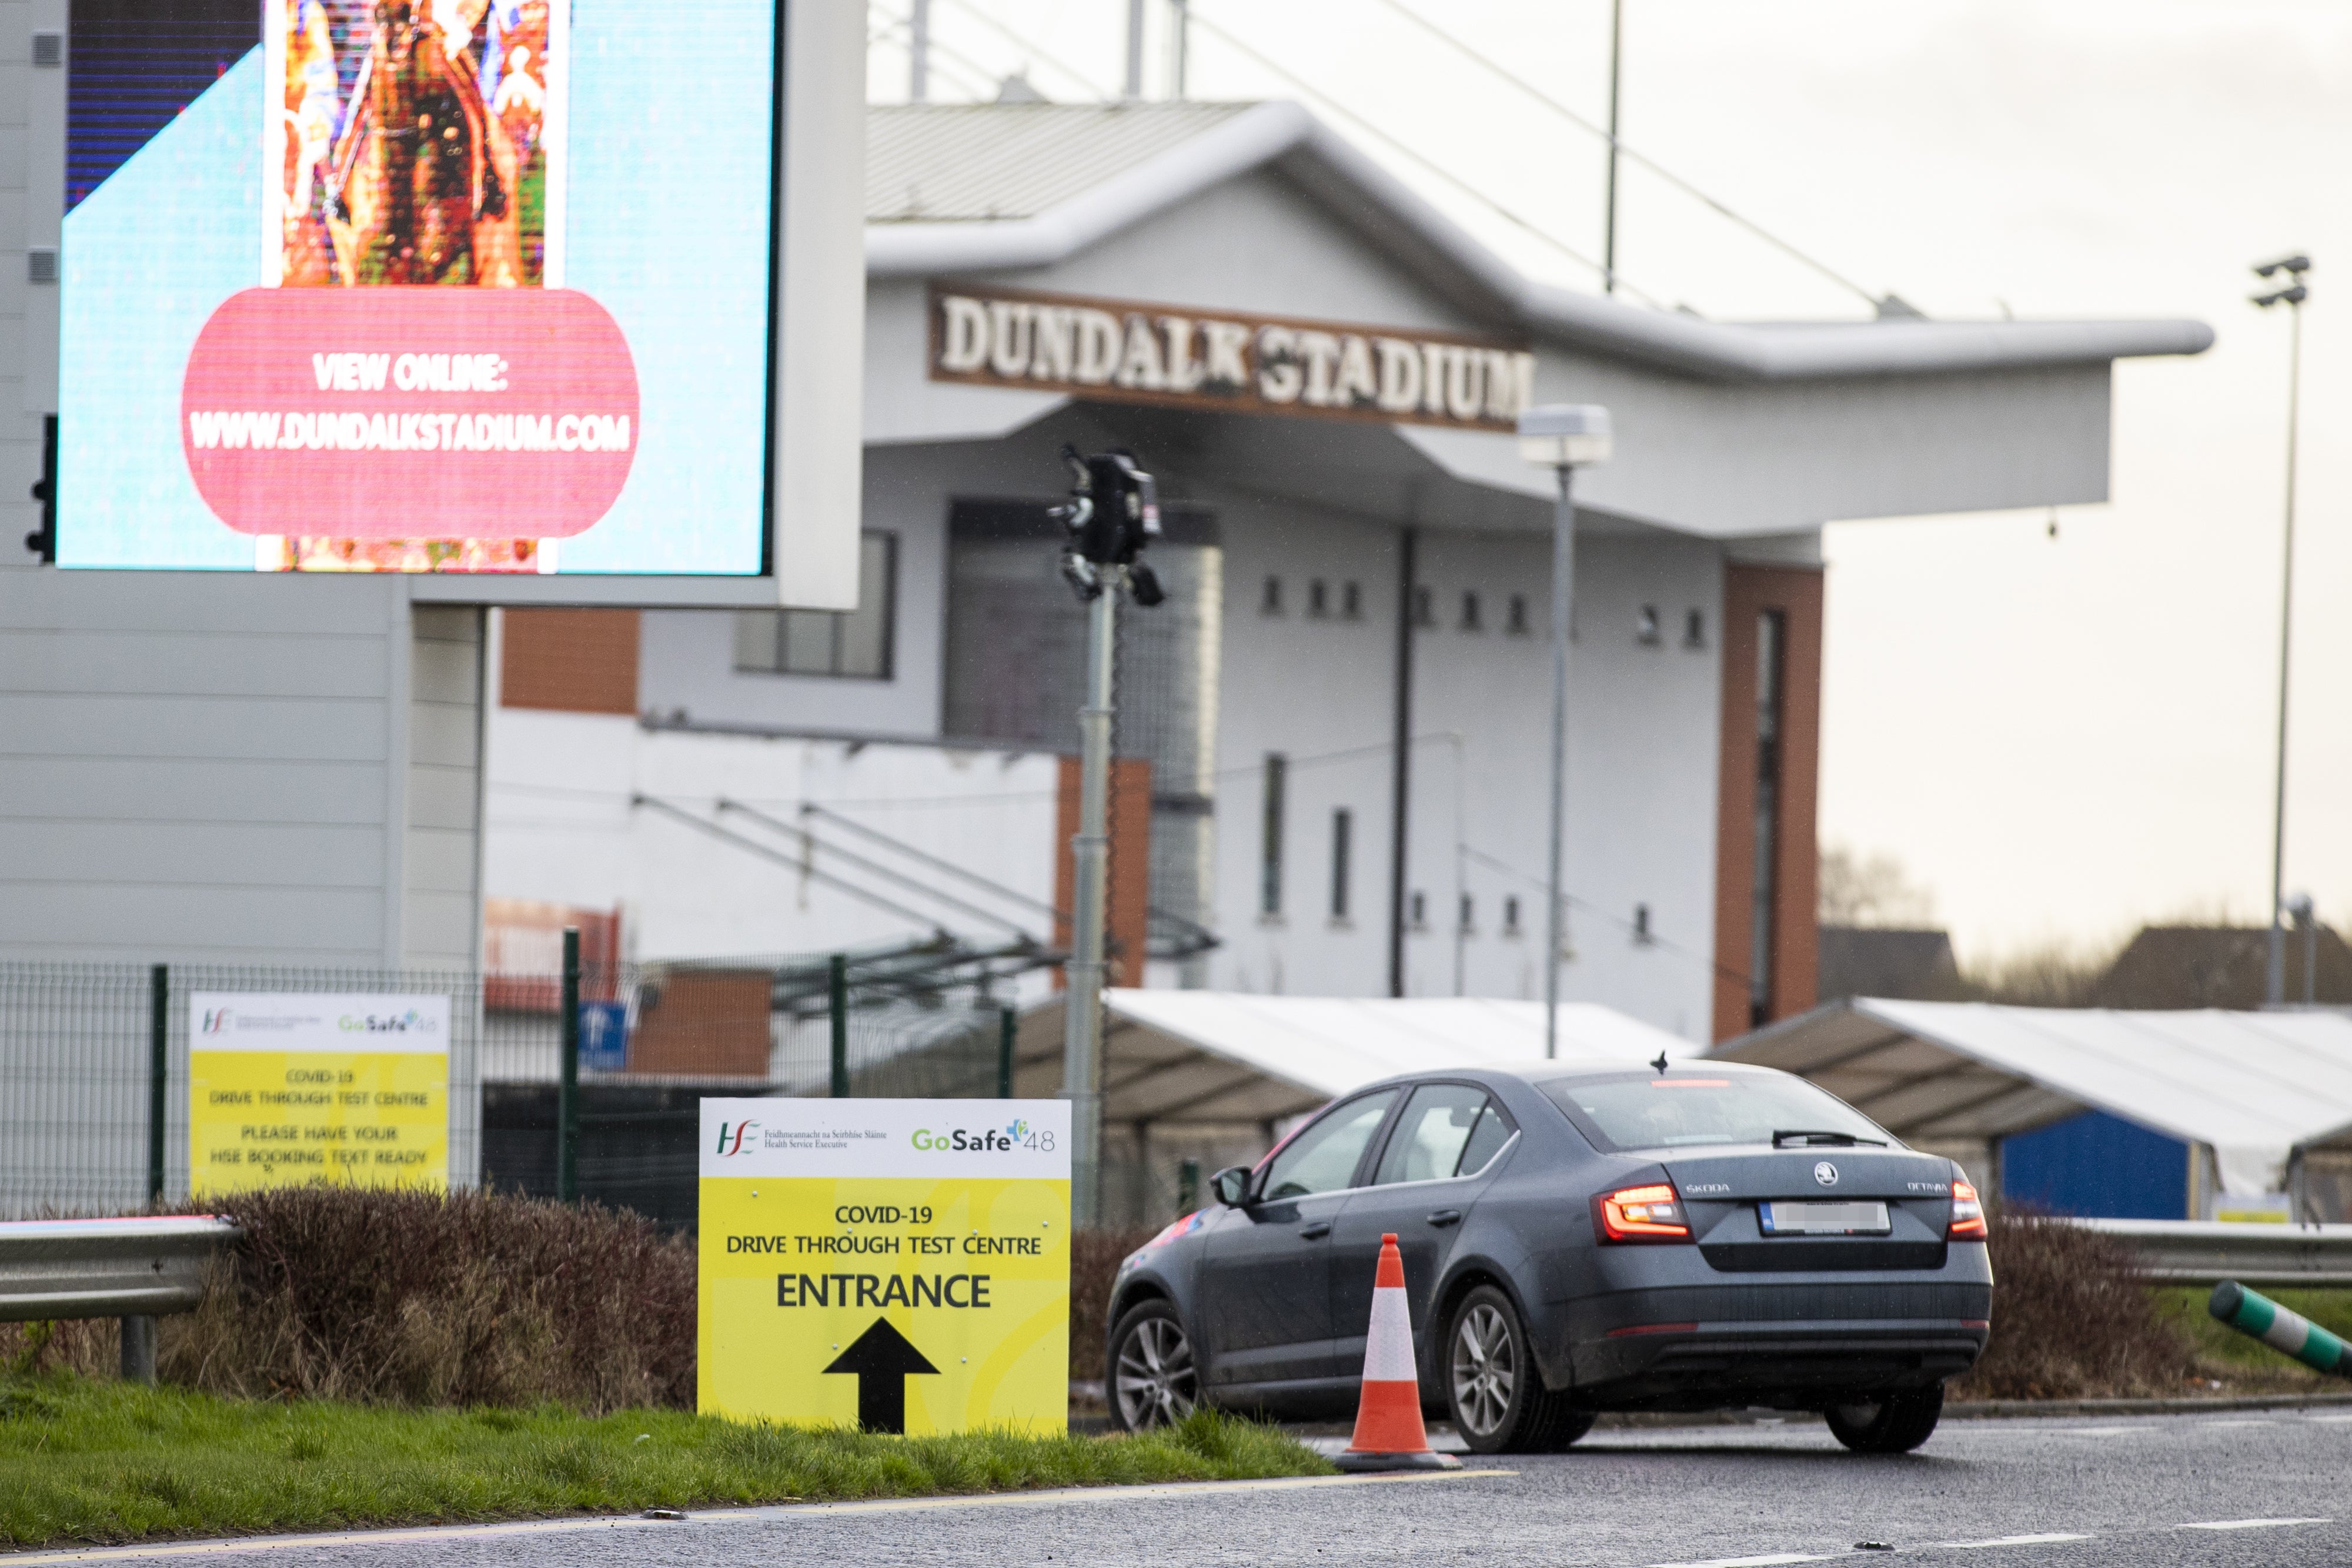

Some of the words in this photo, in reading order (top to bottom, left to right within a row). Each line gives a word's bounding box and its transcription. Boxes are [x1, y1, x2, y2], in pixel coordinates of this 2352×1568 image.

[942, 294, 1252, 396] DUNDALK
[1255, 323, 1534, 421] STADIUM
[313, 353, 390, 391] VIEW
[393, 353, 508, 392] ONLINE:
[190, 412, 631, 452] WWW.DUNDALKSTADIUM.COM
[285, 1070, 355, 1084] COVID-19
[209, 1091, 252, 1106] DRIVE
[259, 1091, 332, 1106] THROUGH
[338, 1092, 369, 1106] TEST
[375, 1092, 428, 1107] CENTRE
[241, 1126, 299, 1141] PLEASE
[305, 1126, 348, 1141] HAVE
[353, 1126, 399, 1141] YOUR
[1023, 1130, 1055, 1152] 48
[764, 1139, 787, 1148] Health
[789, 1139, 813, 1148] Service
[815, 1139, 847, 1148] Executive
[211, 1149, 242, 1164] HSE
[248, 1149, 324, 1165] BOOKING
[332, 1149, 369, 1165] TEXT
[375, 1149, 427, 1165] READY
[1907, 1182, 1948, 1193] OCTAVIA
[835, 1206, 933, 1223] COVID-19
[727, 1236, 786, 1253] DRIVE
[794, 1236, 899, 1254] THROUGH
[907, 1236, 956, 1254] TEST
[963, 1237, 1041, 1255] CENTRE
[777, 1273, 991, 1308] ENTRANCE
